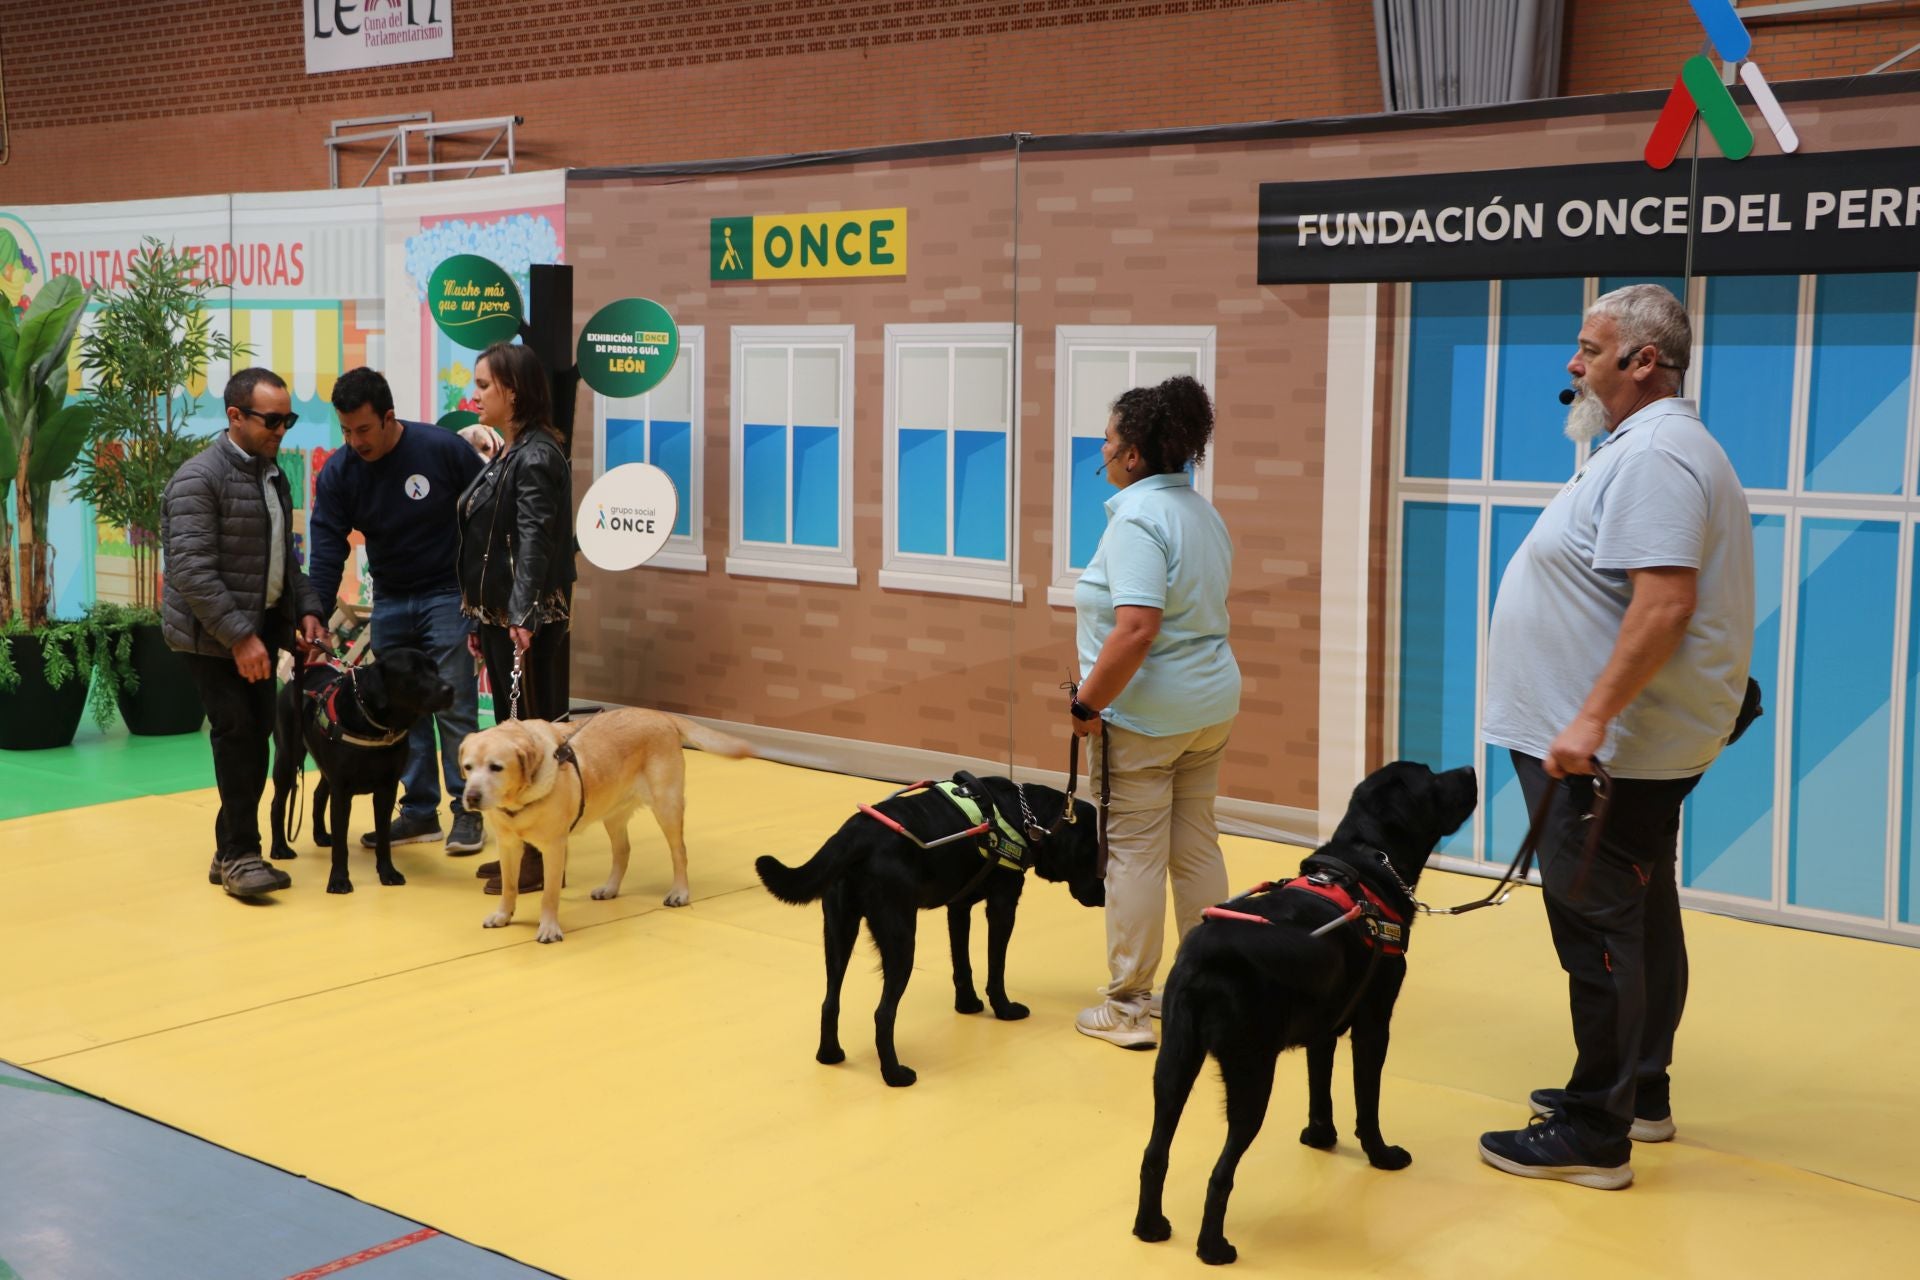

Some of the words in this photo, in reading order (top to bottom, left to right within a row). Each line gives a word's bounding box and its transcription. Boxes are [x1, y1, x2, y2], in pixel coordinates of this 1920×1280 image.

[364, 16, 387, 31] Cuna
[388, 12, 402, 27] del
[365, 26, 443, 47] Parlamentarismo
[1297, 196, 1544, 247] FUNDACIÓN
[1557, 196, 1689, 237] ONCE
[1701, 193, 1792, 233] DEL
[763, 219, 895, 268] ONCE
[443, 279, 480, 296] Mucho
[484, 282, 505, 297] más
[438, 300, 457, 317] que
[461, 300, 475, 311] un
[477, 301, 511, 319] perro
[587, 332, 633, 343] EXHIBICIÓN
[595, 344, 606, 353] DE
[607, 345, 638, 354] PERROS
[639, 345, 659, 355] GUÍA
[609, 356, 646, 373] LEÓN
[610, 506, 633, 516] grupo
[635, 507, 656, 517] social
[610, 517, 655, 534] ONCE
